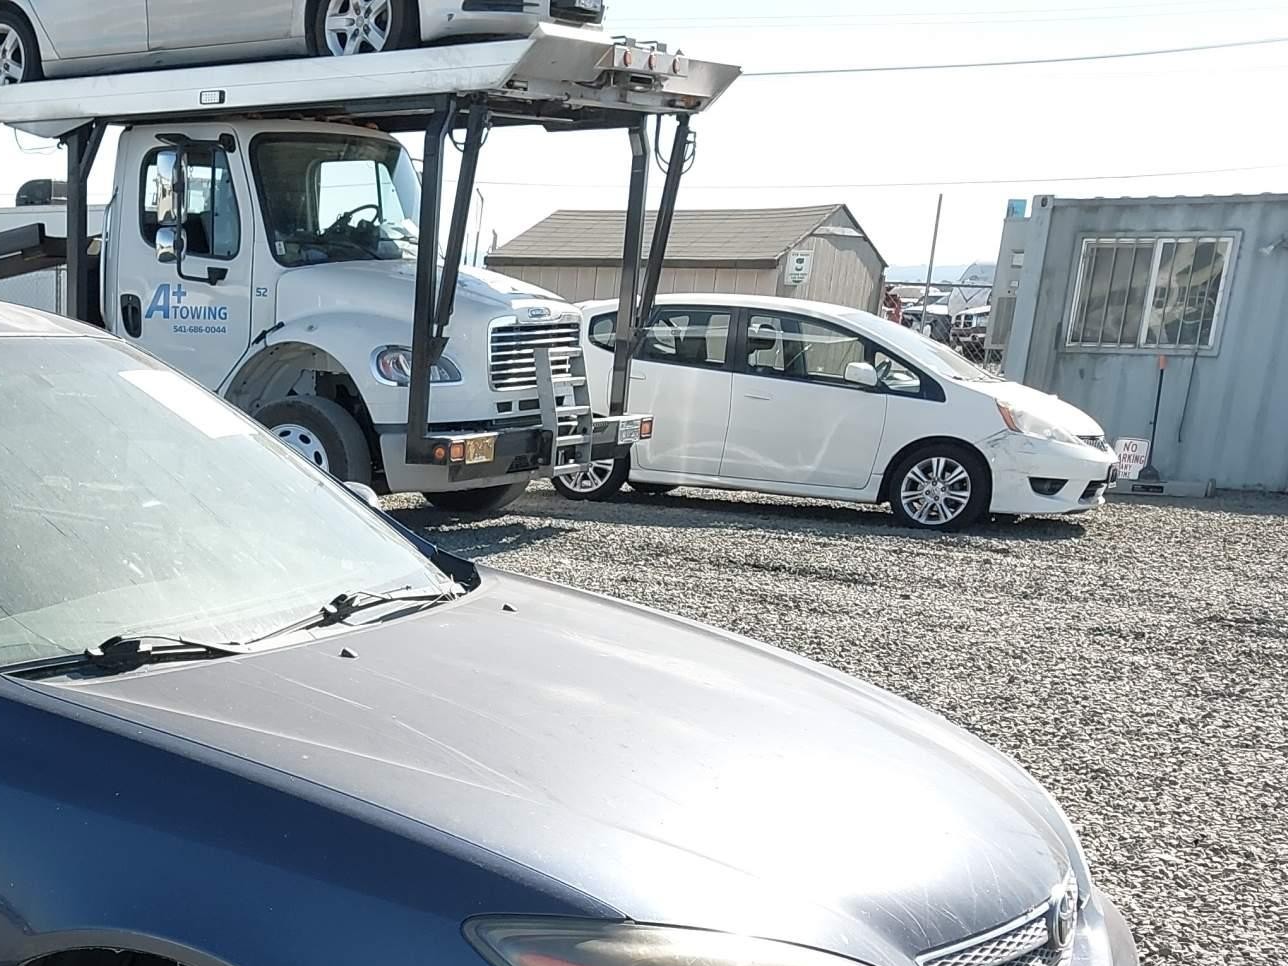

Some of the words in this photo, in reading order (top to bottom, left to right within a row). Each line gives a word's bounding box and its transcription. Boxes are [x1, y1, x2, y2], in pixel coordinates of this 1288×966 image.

[255, 287, 268, 297] 52
[145, 283, 187, 319] A+
[172, 305, 228, 320] TOWING
[173, 325, 226, 333] 541-686-0044
[1123, 441, 1138, 453] NO
[1117, 453, 1145, 464] ARKING
